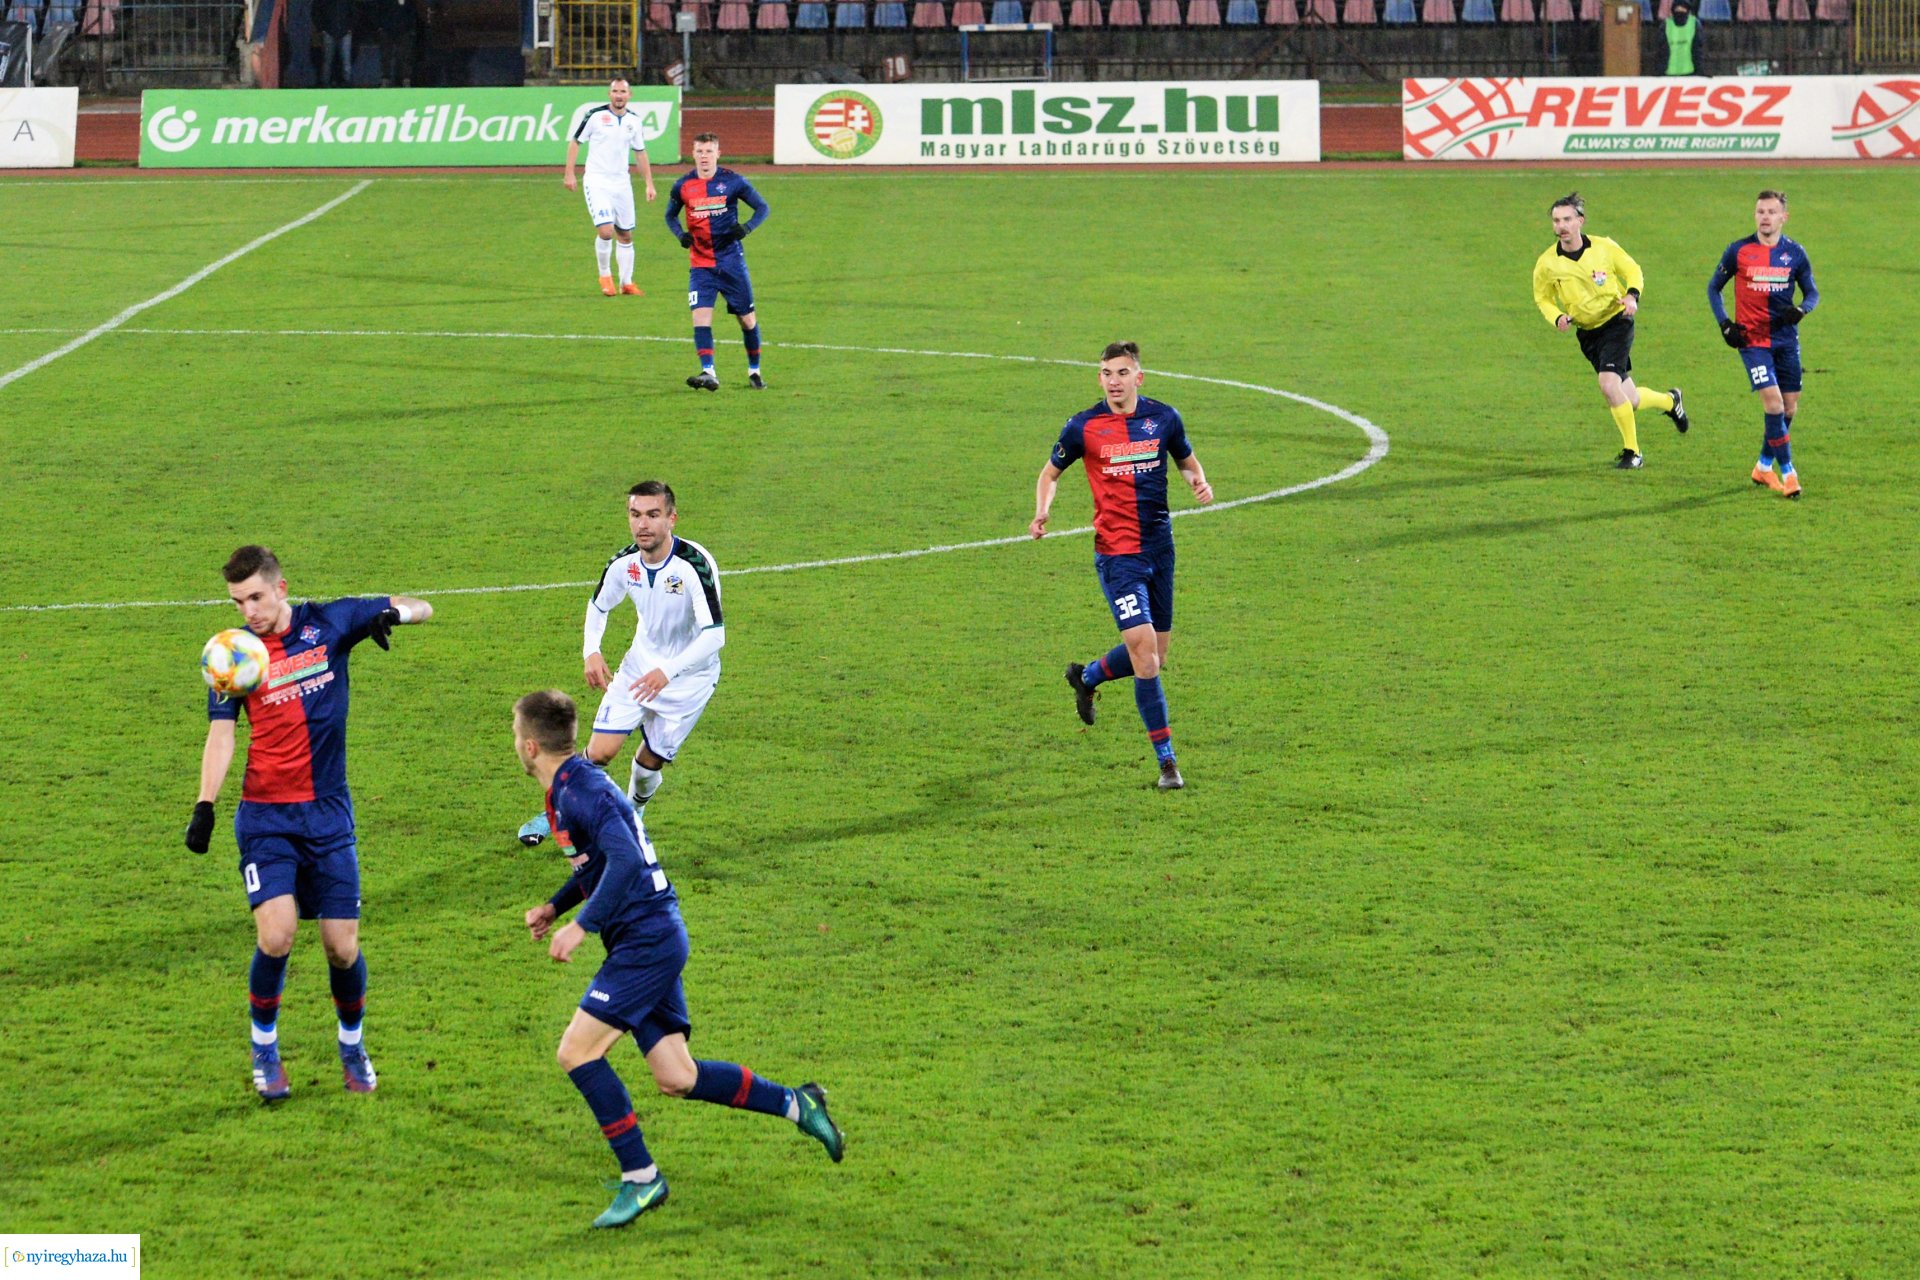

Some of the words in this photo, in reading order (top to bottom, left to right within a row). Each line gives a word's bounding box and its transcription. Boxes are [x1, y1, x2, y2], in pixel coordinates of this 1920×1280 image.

[211, 103, 564, 144] merkantilbank
[920, 88, 1280, 135] mlsz.hu
[12, 119, 35, 142] A
[1568, 136, 1630, 150] ALWAYS
[1633, 136, 1656, 149] ON
[1660, 136, 1689, 149] THE
[1691, 136, 1736, 149] RIGHT
[1740, 136, 1775, 149] WAY
[920, 141, 1007, 159] Magyar
[1019, 138, 1146, 158] Labdarúgó
[1157, 137, 1280, 157] Szövetség
[1750, 364, 1769, 385] 22
[1114, 593, 1142, 620] 32
[267, 644, 328, 680] EVESZ
